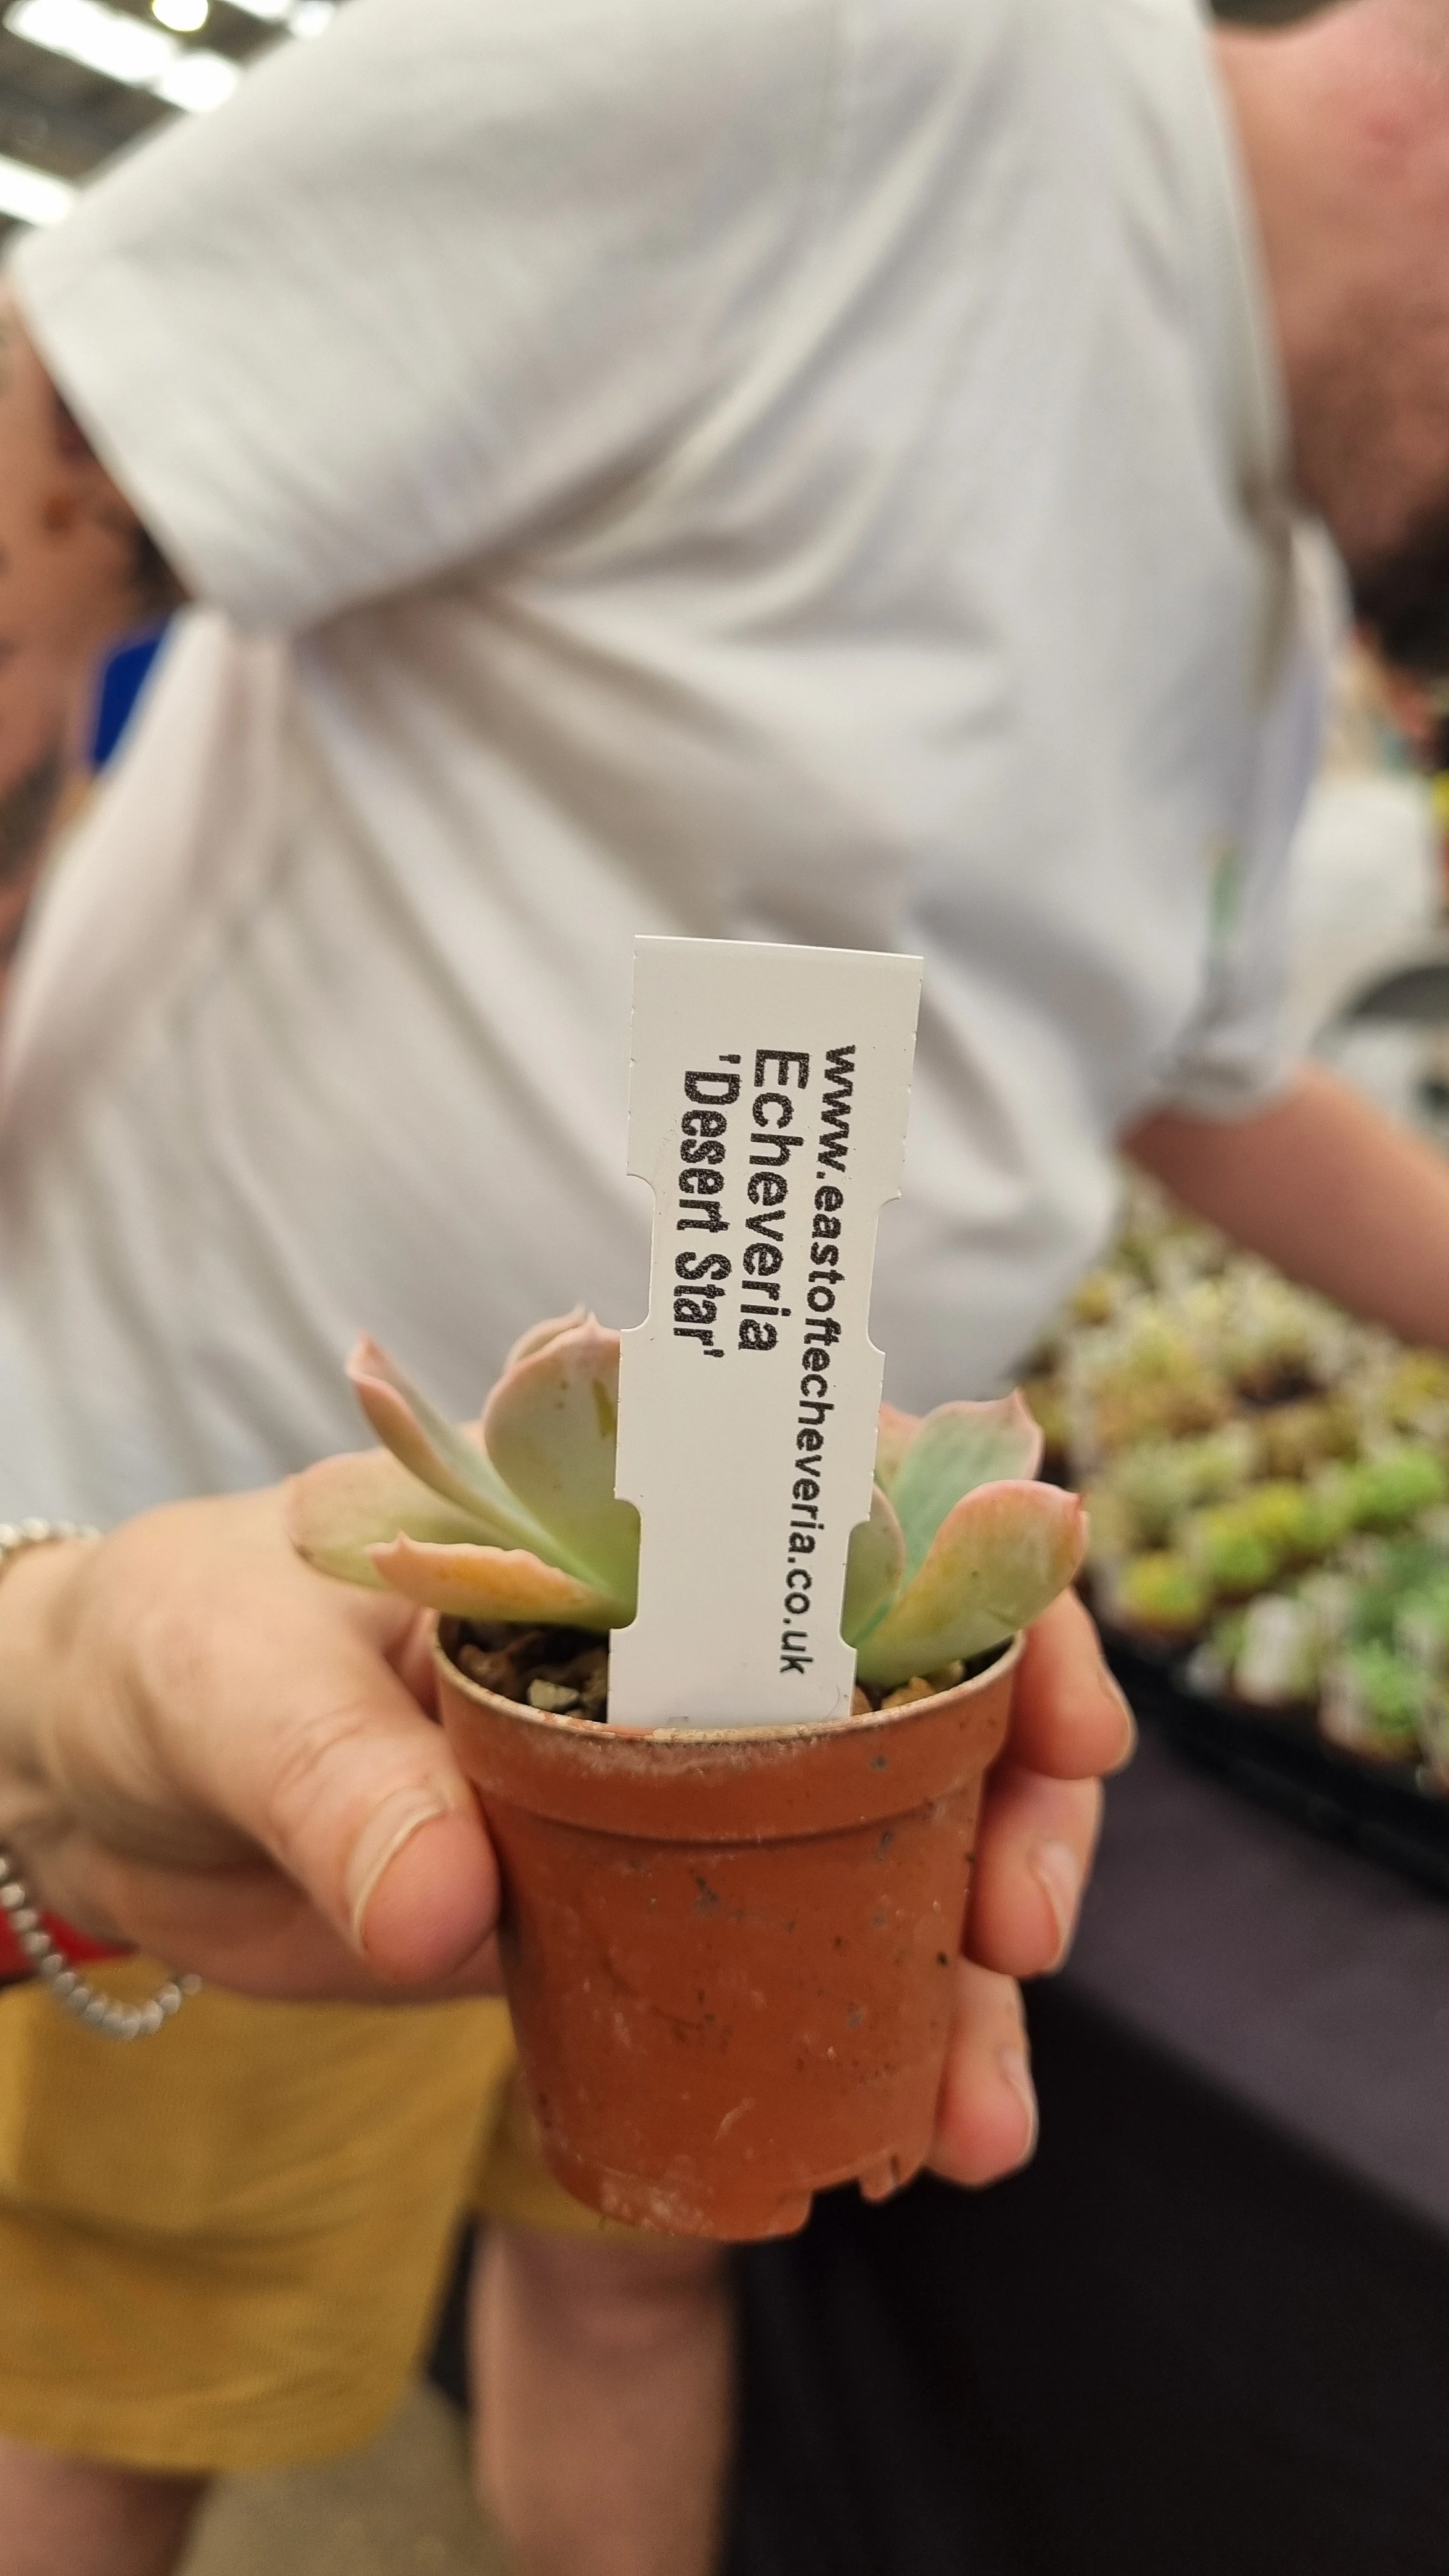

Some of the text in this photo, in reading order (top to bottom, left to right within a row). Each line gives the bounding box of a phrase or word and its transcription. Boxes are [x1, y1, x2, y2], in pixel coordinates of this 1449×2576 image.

[673, 1054, 743, 1358] 'Desert Star'
[738, 1048, 810, 1352] Echeveria
[779, 1044, 857, 1675] www.eastoftecheveria.co.uk
